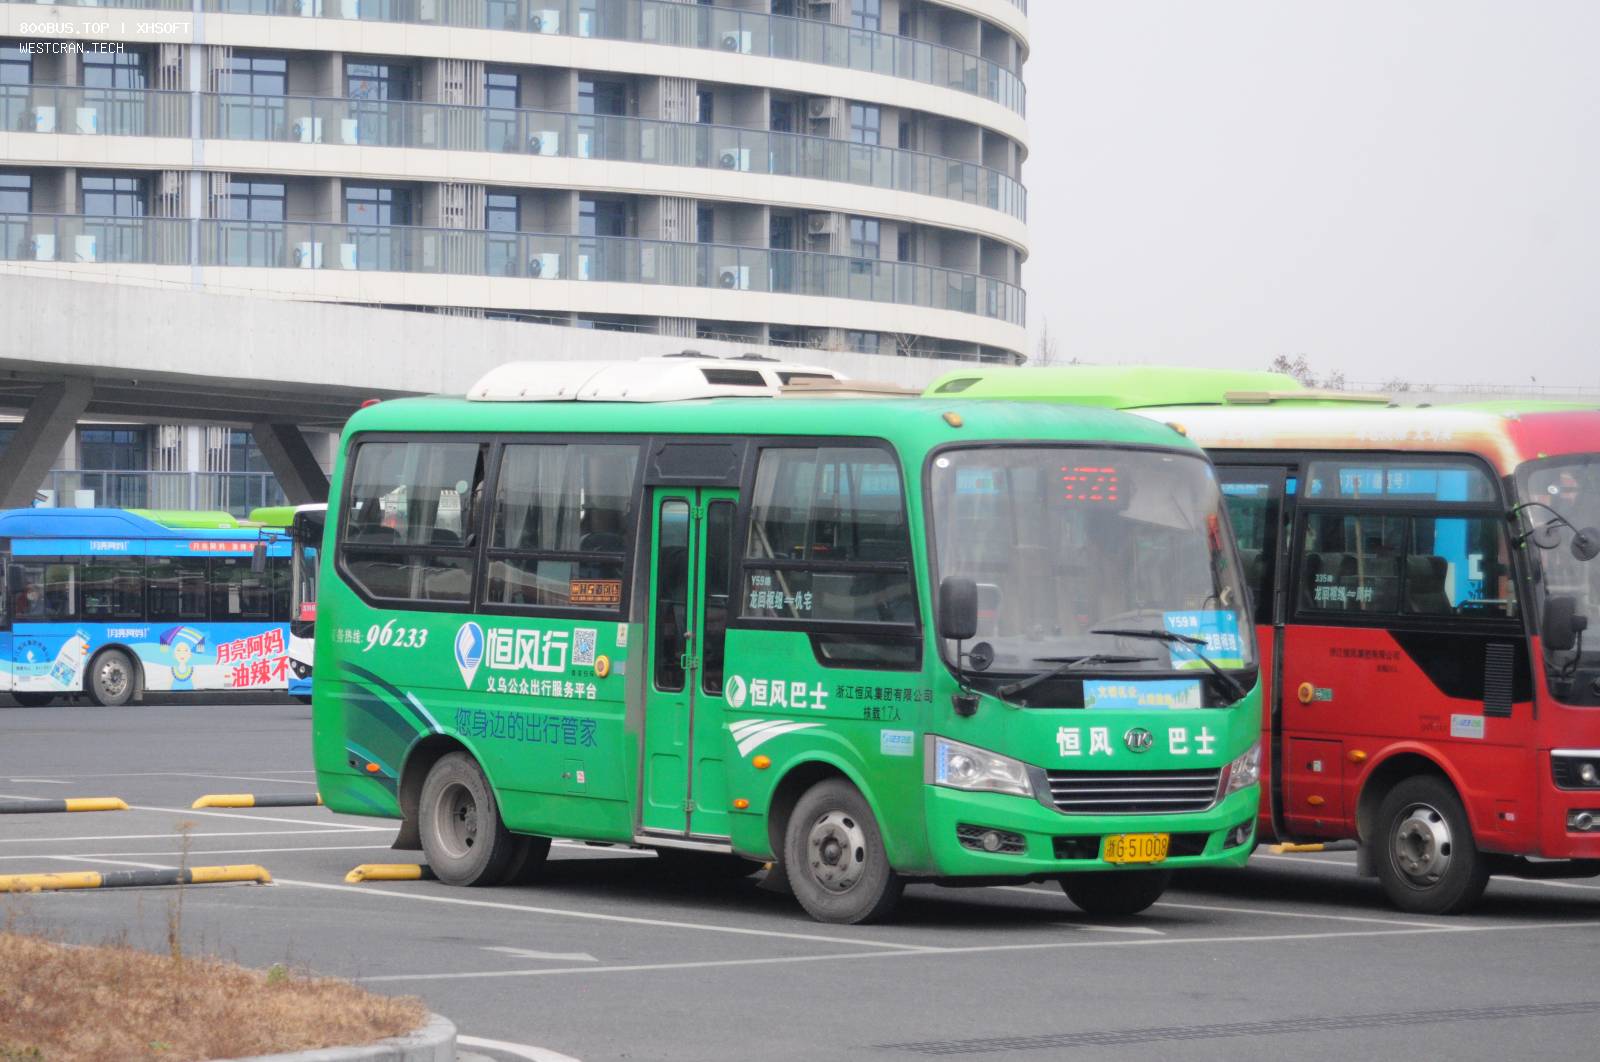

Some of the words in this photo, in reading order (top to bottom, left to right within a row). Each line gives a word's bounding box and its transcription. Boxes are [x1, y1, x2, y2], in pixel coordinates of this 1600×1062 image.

[215, 628, 283, 665] 月亮阿妈
[362, 617, 429, 651] 96233
[485, 627, 569, 673] 恒风行
[486, 676, 597, 700] 义乌公众出行服务平台
[749, 678, 829, 710] 恒风巴士
[836, 685, 934, 703] 浙江恒风集团有限公司
[455, 708, 597, 747] 您身边的出行管家
[1056, 726, 1113, 757] 恒风
[1168, 726, 1215, 755] 巴士
